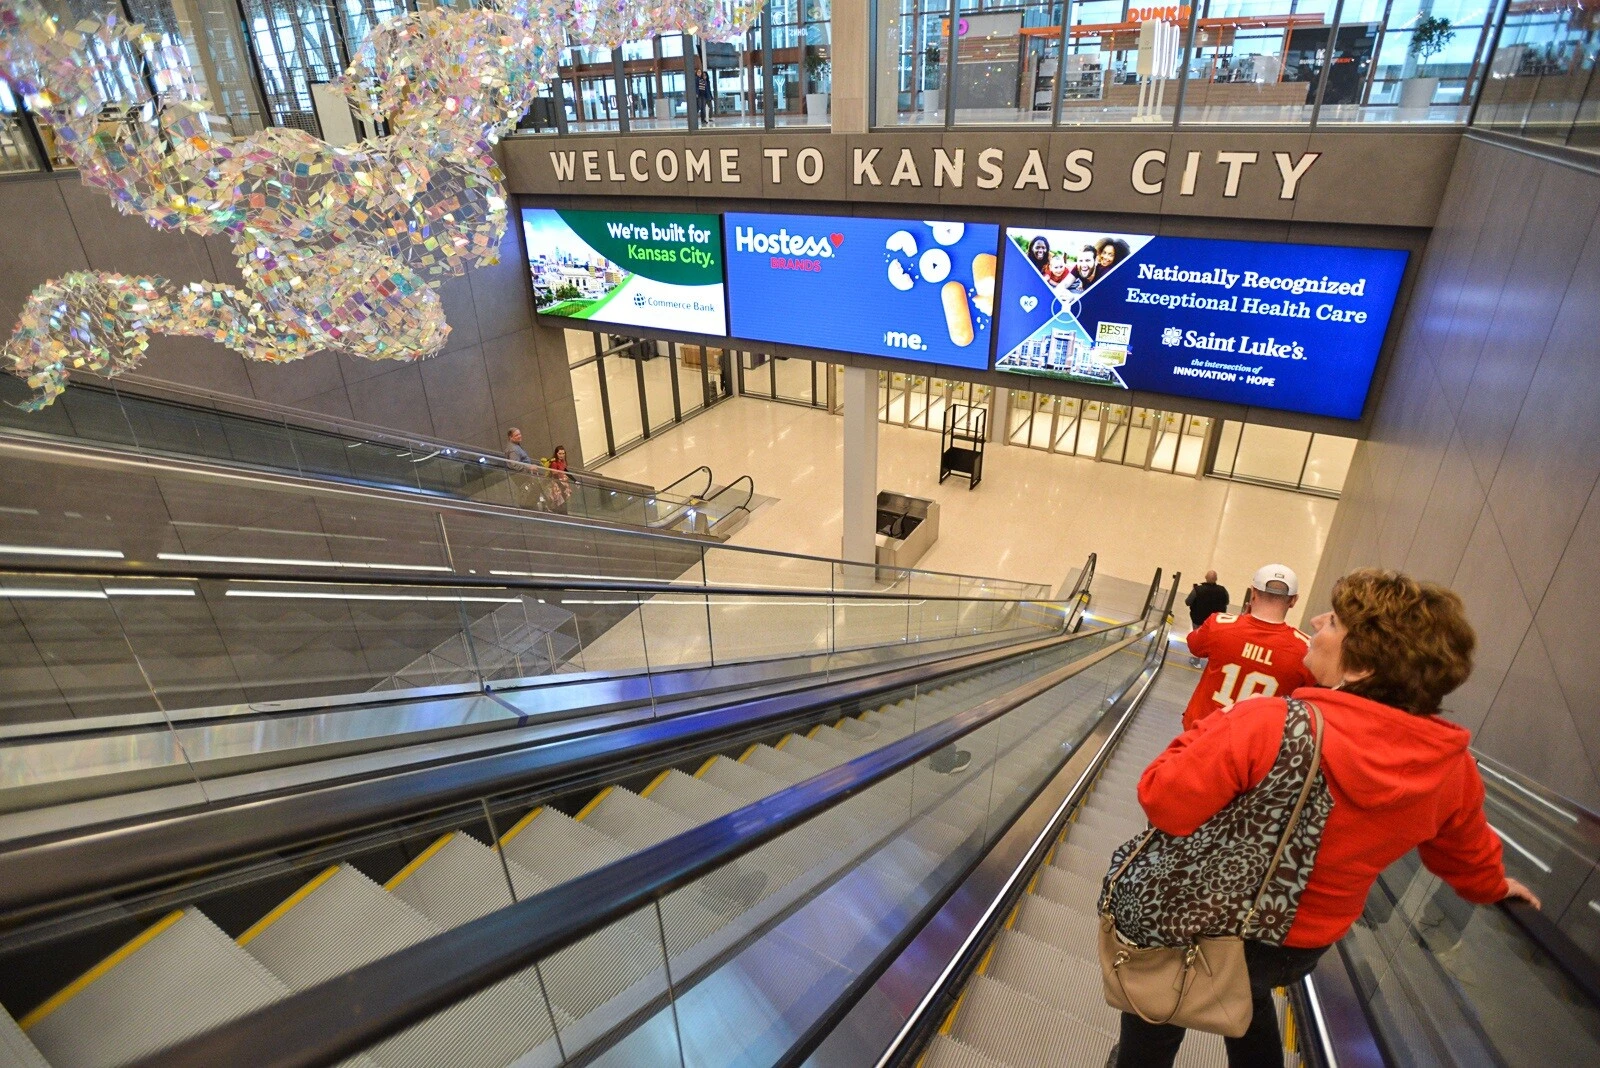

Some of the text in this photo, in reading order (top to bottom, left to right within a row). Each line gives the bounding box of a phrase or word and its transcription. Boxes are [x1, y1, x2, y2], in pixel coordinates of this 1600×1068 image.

[549, 147, 1321, 200] WELCOME TO KANSAS CITY
[606, 222, 711, 244] We're built for
[627, 245, 714, 268] Kansas City.
[770, 257, 822, 273] BRANDS
[1137, 263, 1366, 297] Nationally Recognized
[648, 297, 715, 312] Commerce Bank
[1126, 287, 1368, 324] Exceptional Health Care
[884, 331, 928, 351] me.
[1099, 324, 1129, 337] BEST
[1183, 330, 1236, 353] Saint
[1173, 366, 1236, 382] INNOVATION
[1246, 375, 1276, 387] HOPE
[1191, 359, 1263, 375] the intersection of
[1241, 642, 1273, 666] HILL
[1212, 662, 1280, 707] 10
